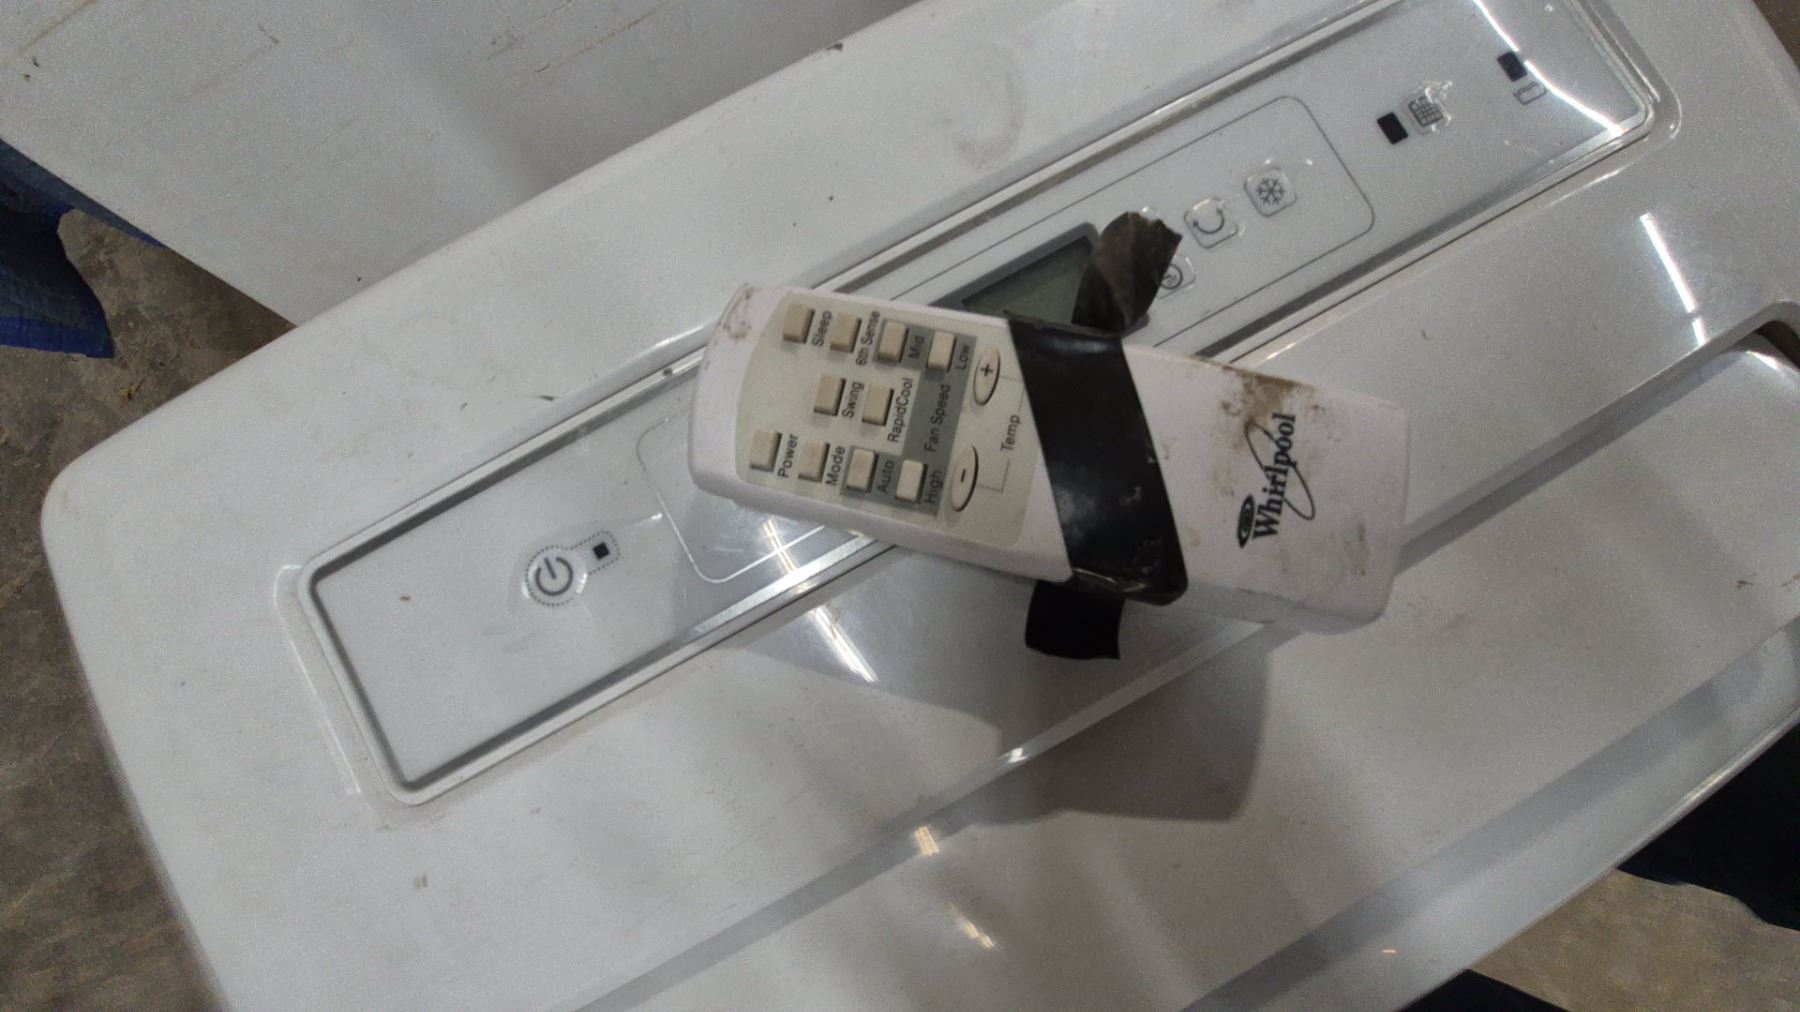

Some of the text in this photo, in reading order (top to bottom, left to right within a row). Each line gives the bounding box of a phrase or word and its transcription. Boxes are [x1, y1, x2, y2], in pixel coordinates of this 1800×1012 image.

[811, 310, 832, 347] Sleep
[855, 310, 880, 366] 6th Sense
[908, 336, 925, 359] Mid
[954, 344, 971, 370] Low
[841, 381, 864, 418] Swing
[923, 383, 951, 452] Fan Speed
[1000, 414, 1022, 452] Temp
[777, 433, 799, 478] Power
[825, 446, 846, 487] Mode
[877, 460, 895, 495] Auto
[924, 470, 944, 504] High
[1252, 412, 1298, 540] Whirlpool
